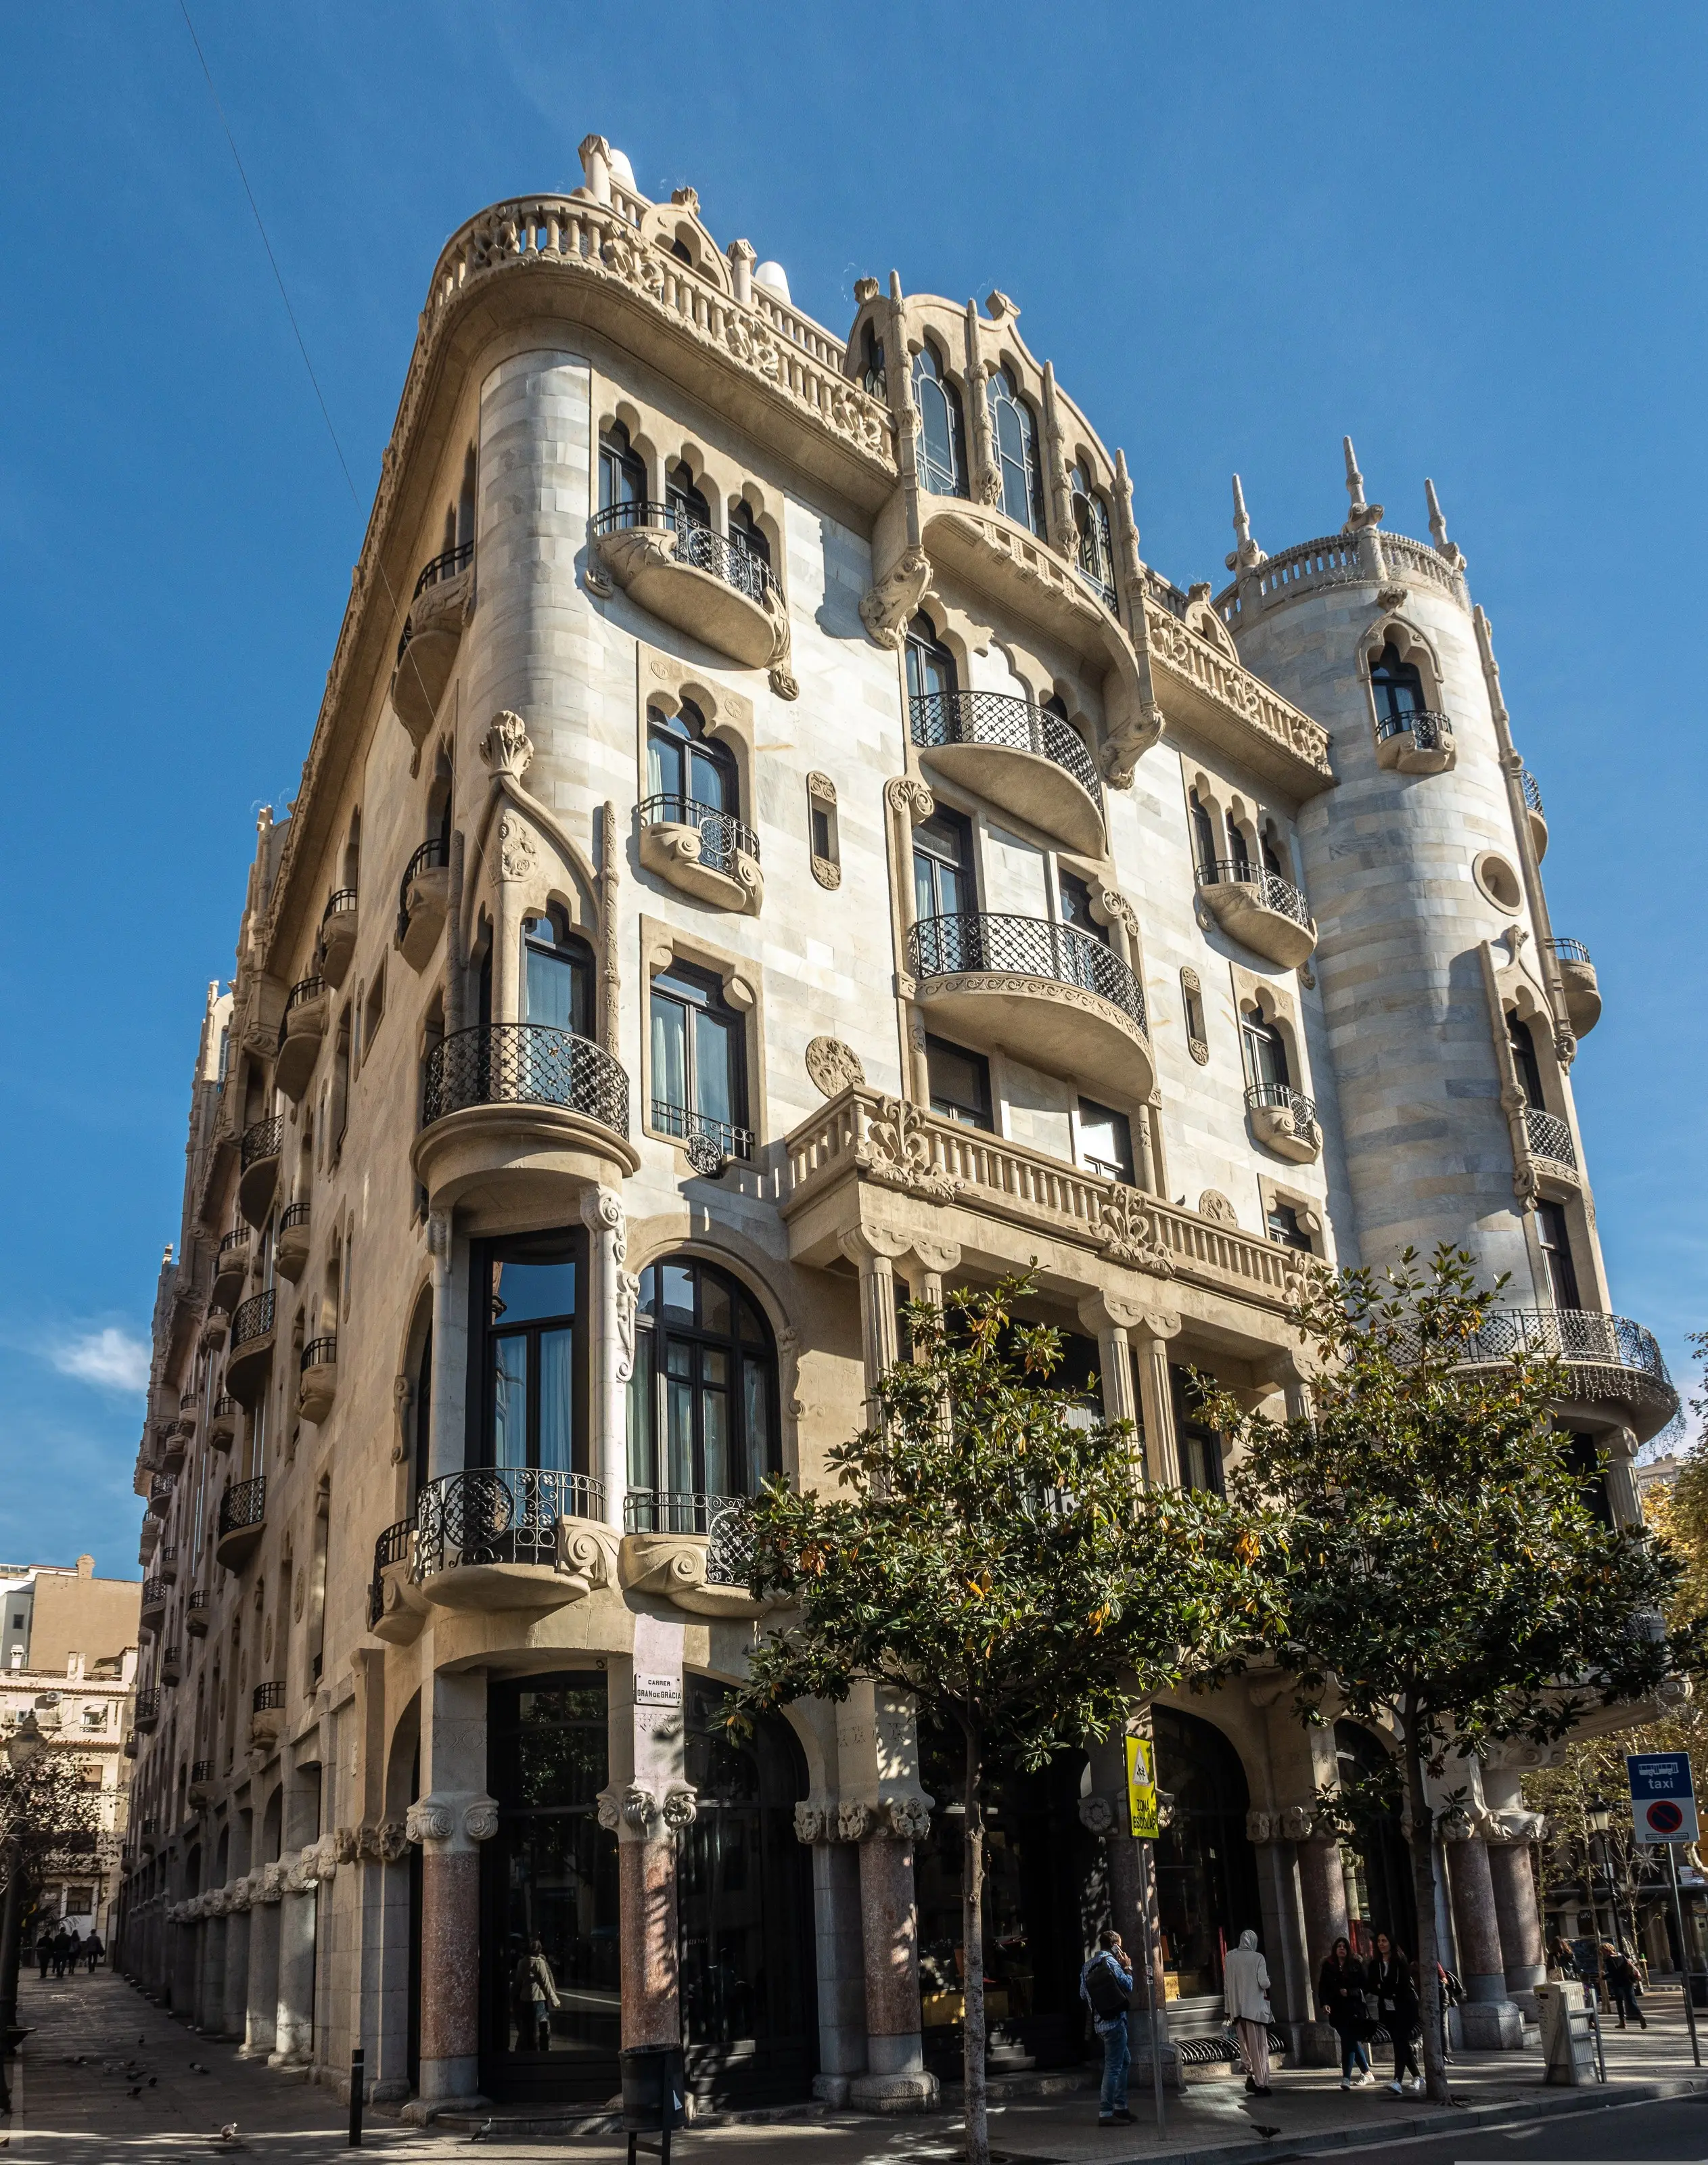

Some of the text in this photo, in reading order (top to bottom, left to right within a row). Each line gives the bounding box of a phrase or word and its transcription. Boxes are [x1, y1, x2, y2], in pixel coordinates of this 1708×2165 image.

[637, 1689, 652, 1697] GRAN
[661, 1689, 681, 1700] GRÀCIA
[1648, 1778, 1674, 1789] taxi
[1136, 1799, 1150, 1812] ZONA
[1133, 1816, 1156, 1830] ESCOLAR
